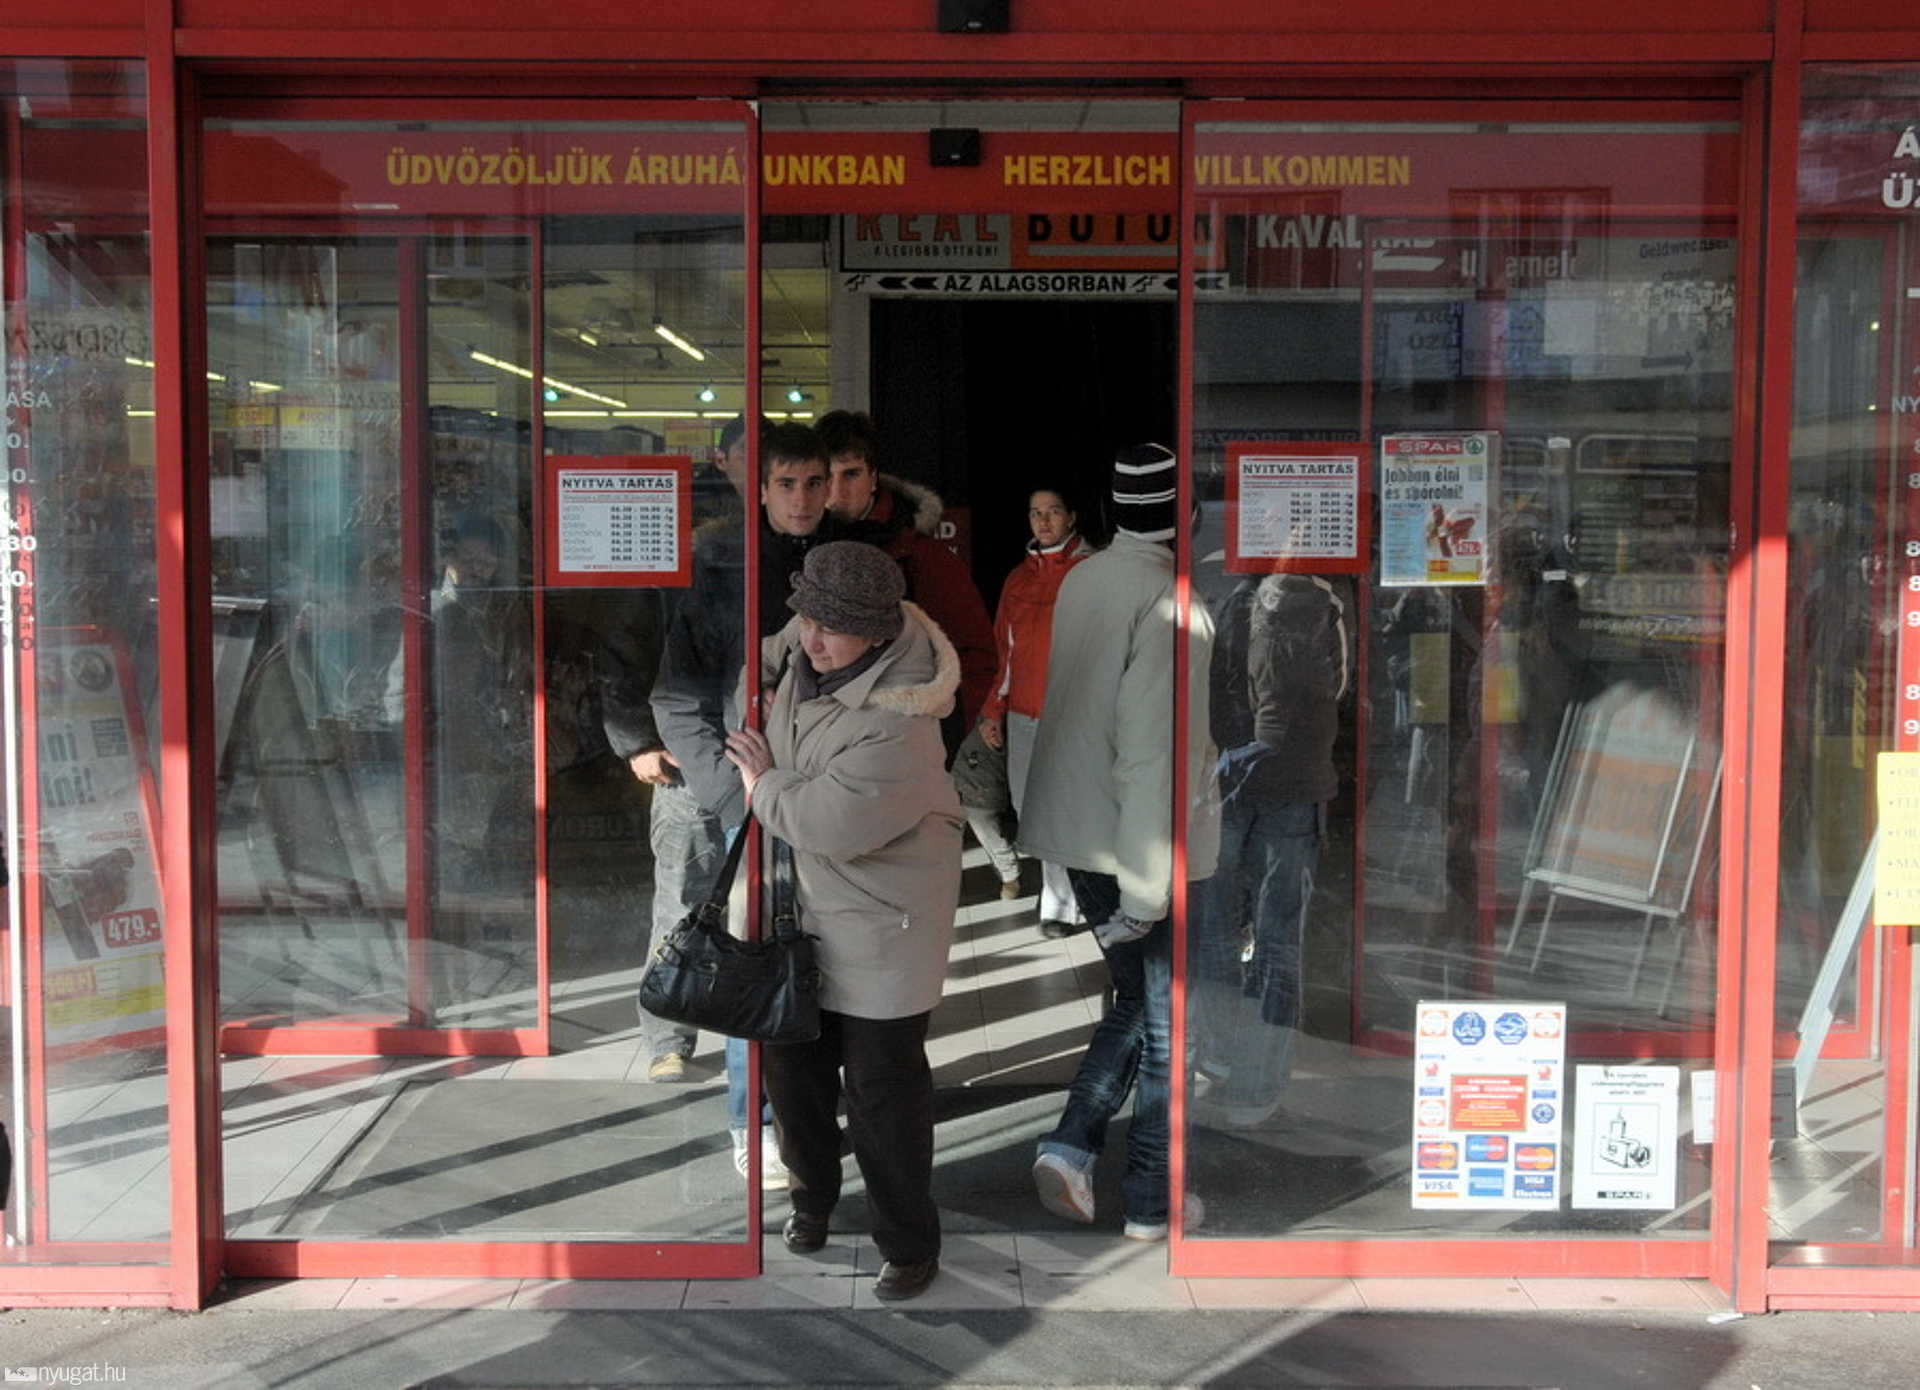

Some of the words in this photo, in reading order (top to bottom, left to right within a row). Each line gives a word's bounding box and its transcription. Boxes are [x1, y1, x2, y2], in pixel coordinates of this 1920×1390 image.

[387, 147, 611, 185] ÜDVÖZÖLJÜK
[624, 146, 905, 187] ÁRUHÁUNKBAN
[1003, 155, 1170, 187] HERZLICH
[943, 276, 971, 292] AZ
[979, 275, 1127, 293] ALAGSORBAN
[1243, 463, 1295, 475] NYITVA
[562, 477, 614, 489] NYITVA
